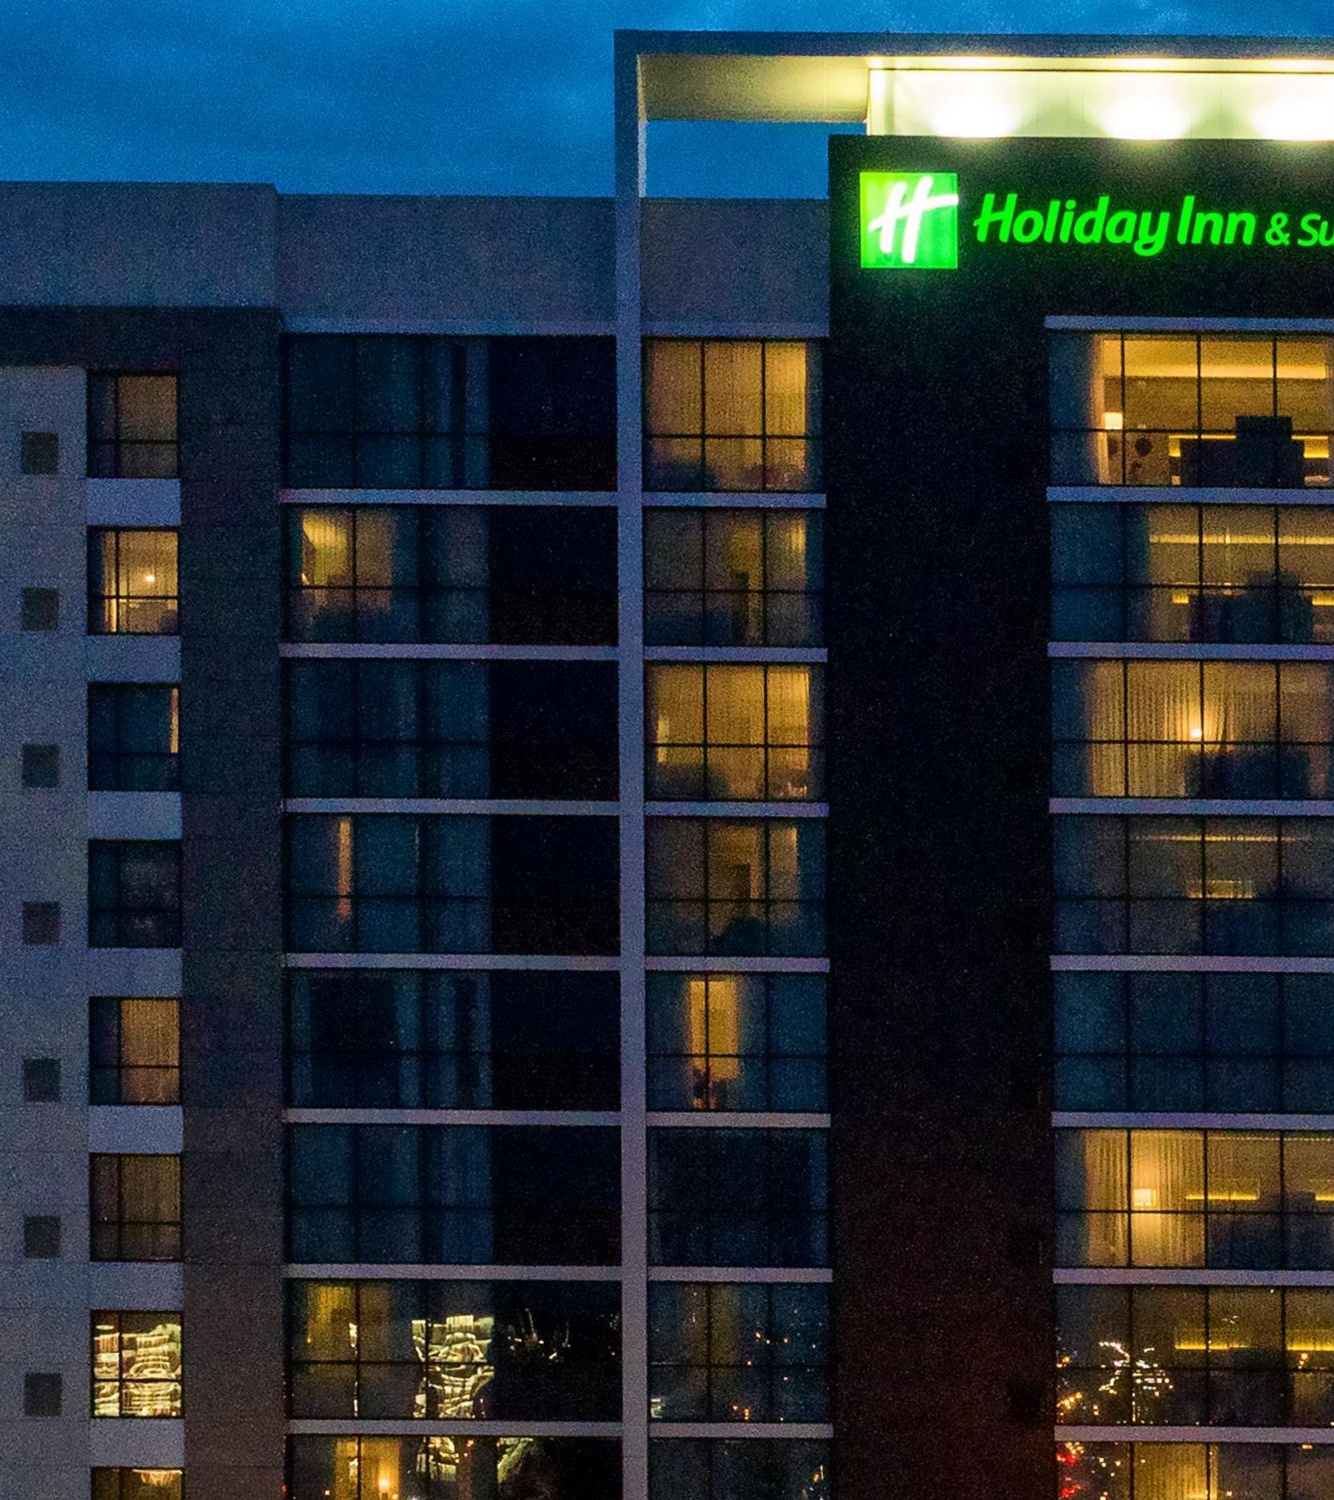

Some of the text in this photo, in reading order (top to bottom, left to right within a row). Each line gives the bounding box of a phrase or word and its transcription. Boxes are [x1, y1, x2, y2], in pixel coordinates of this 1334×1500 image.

[973, 193, 1170, 257] Holiday
[1177, 195, 1256, 245] Inn
[1265, 212, 1290, 246] &
